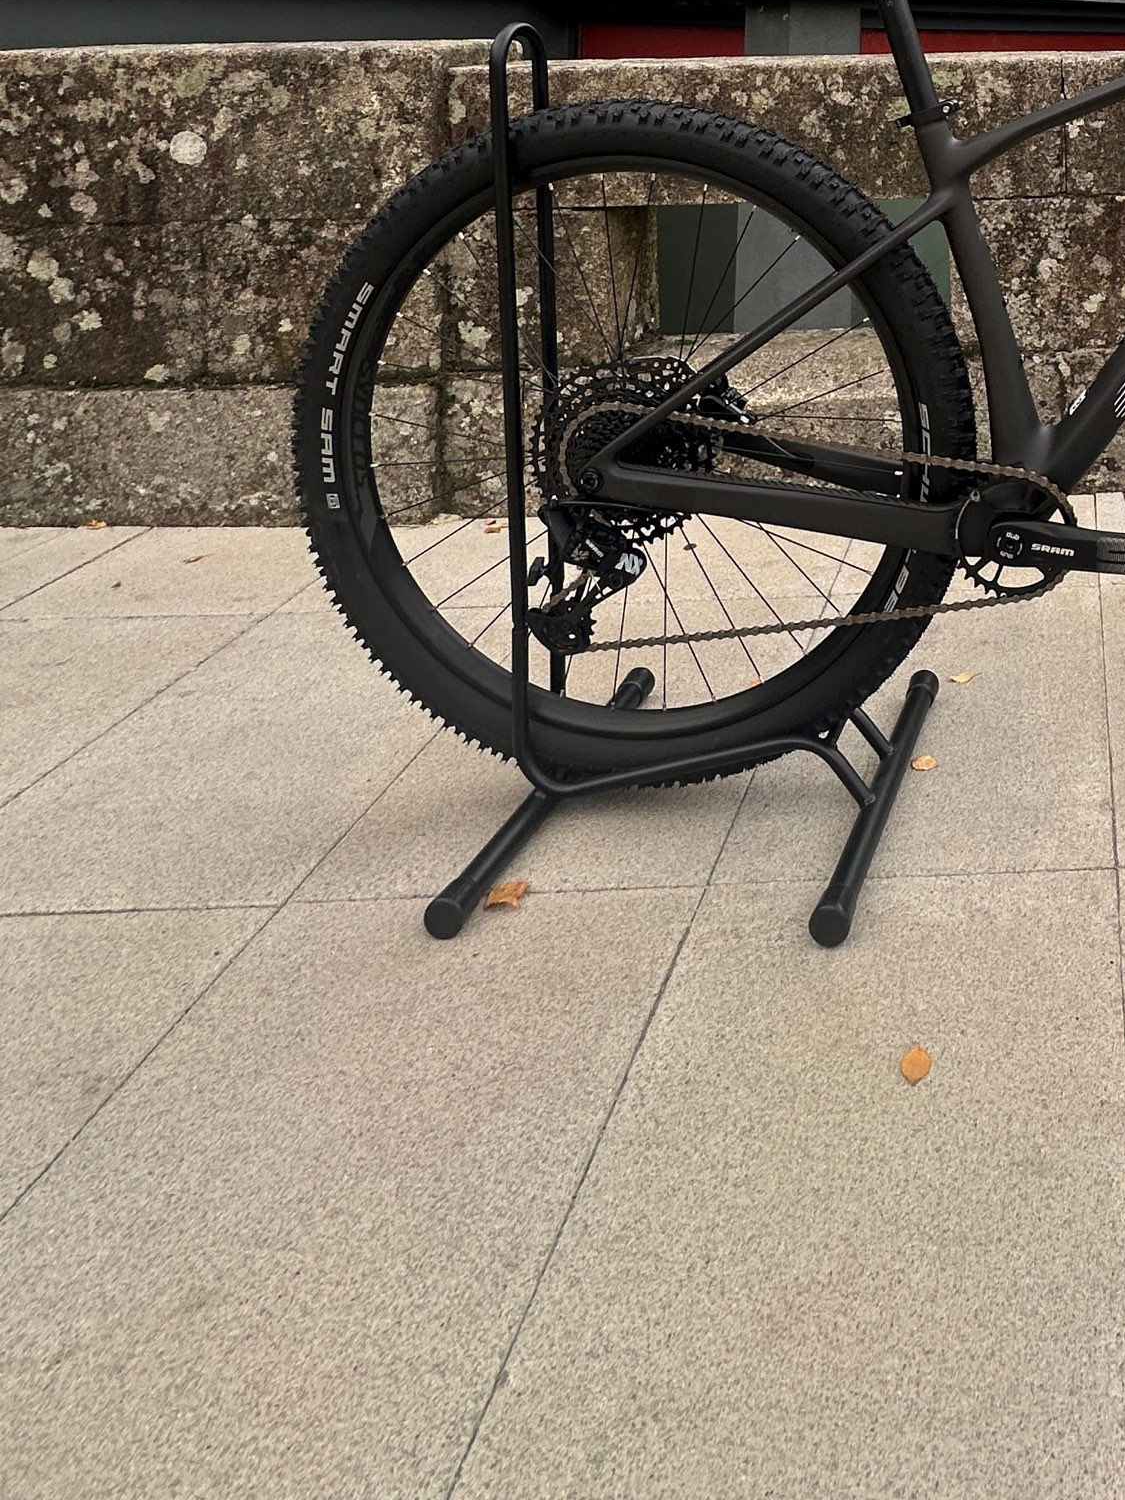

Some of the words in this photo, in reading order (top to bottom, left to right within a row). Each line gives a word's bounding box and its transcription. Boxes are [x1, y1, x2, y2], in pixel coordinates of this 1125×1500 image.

[325, 281, 375, 396] SMART
[320, 407, 336, 483] SAM
[1030, 542, 1075, 557] SRAM
